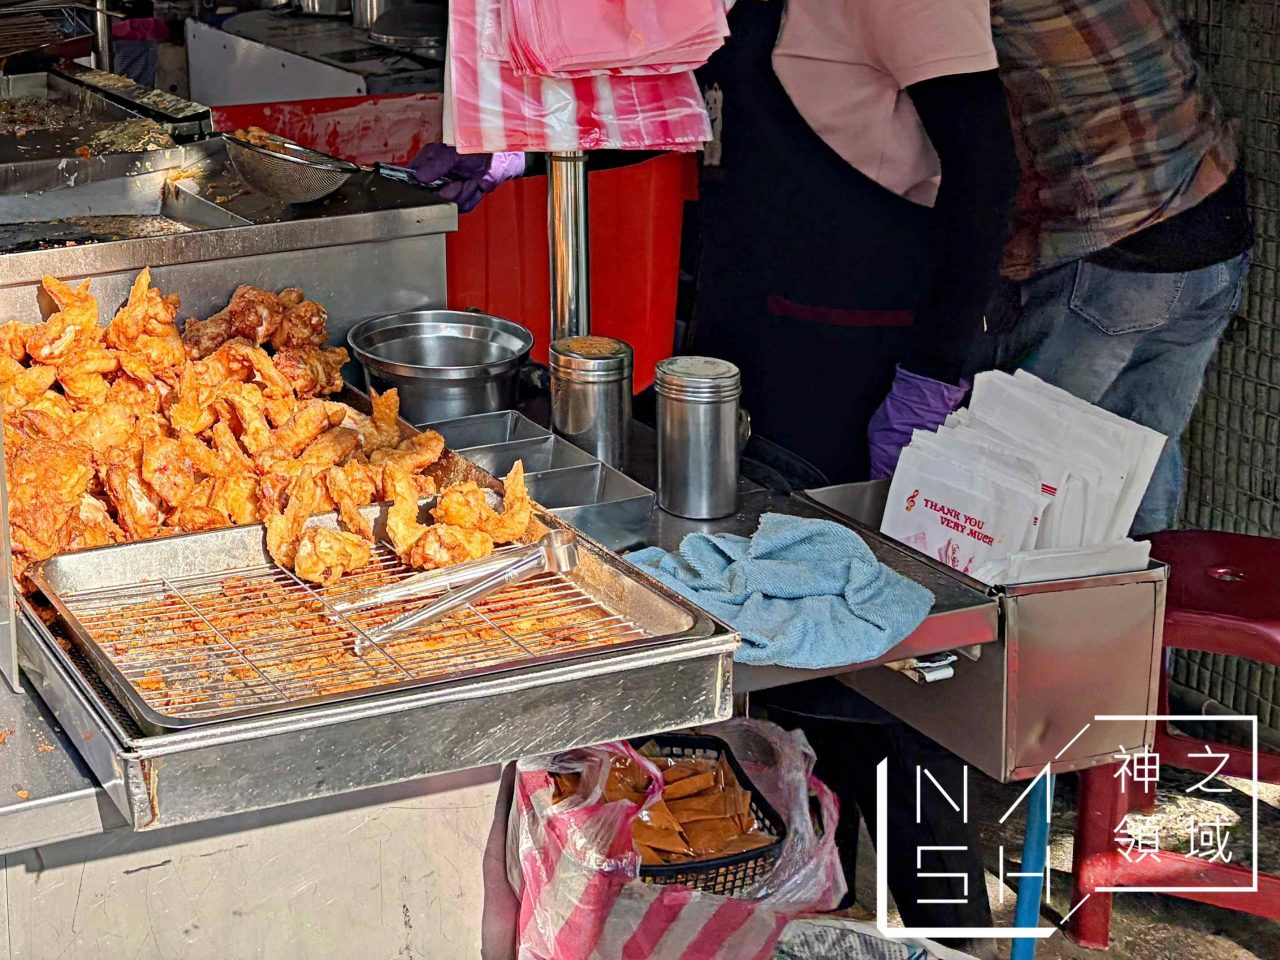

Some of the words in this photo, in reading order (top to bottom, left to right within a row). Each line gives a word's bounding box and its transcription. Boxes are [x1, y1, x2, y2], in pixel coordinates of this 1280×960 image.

[923, 498, 960, 521] THANK
[963, 512, 985, 530] YOU
[939, 515, 968, 536] VERY
[969, 528, 995, 547] MUCH
